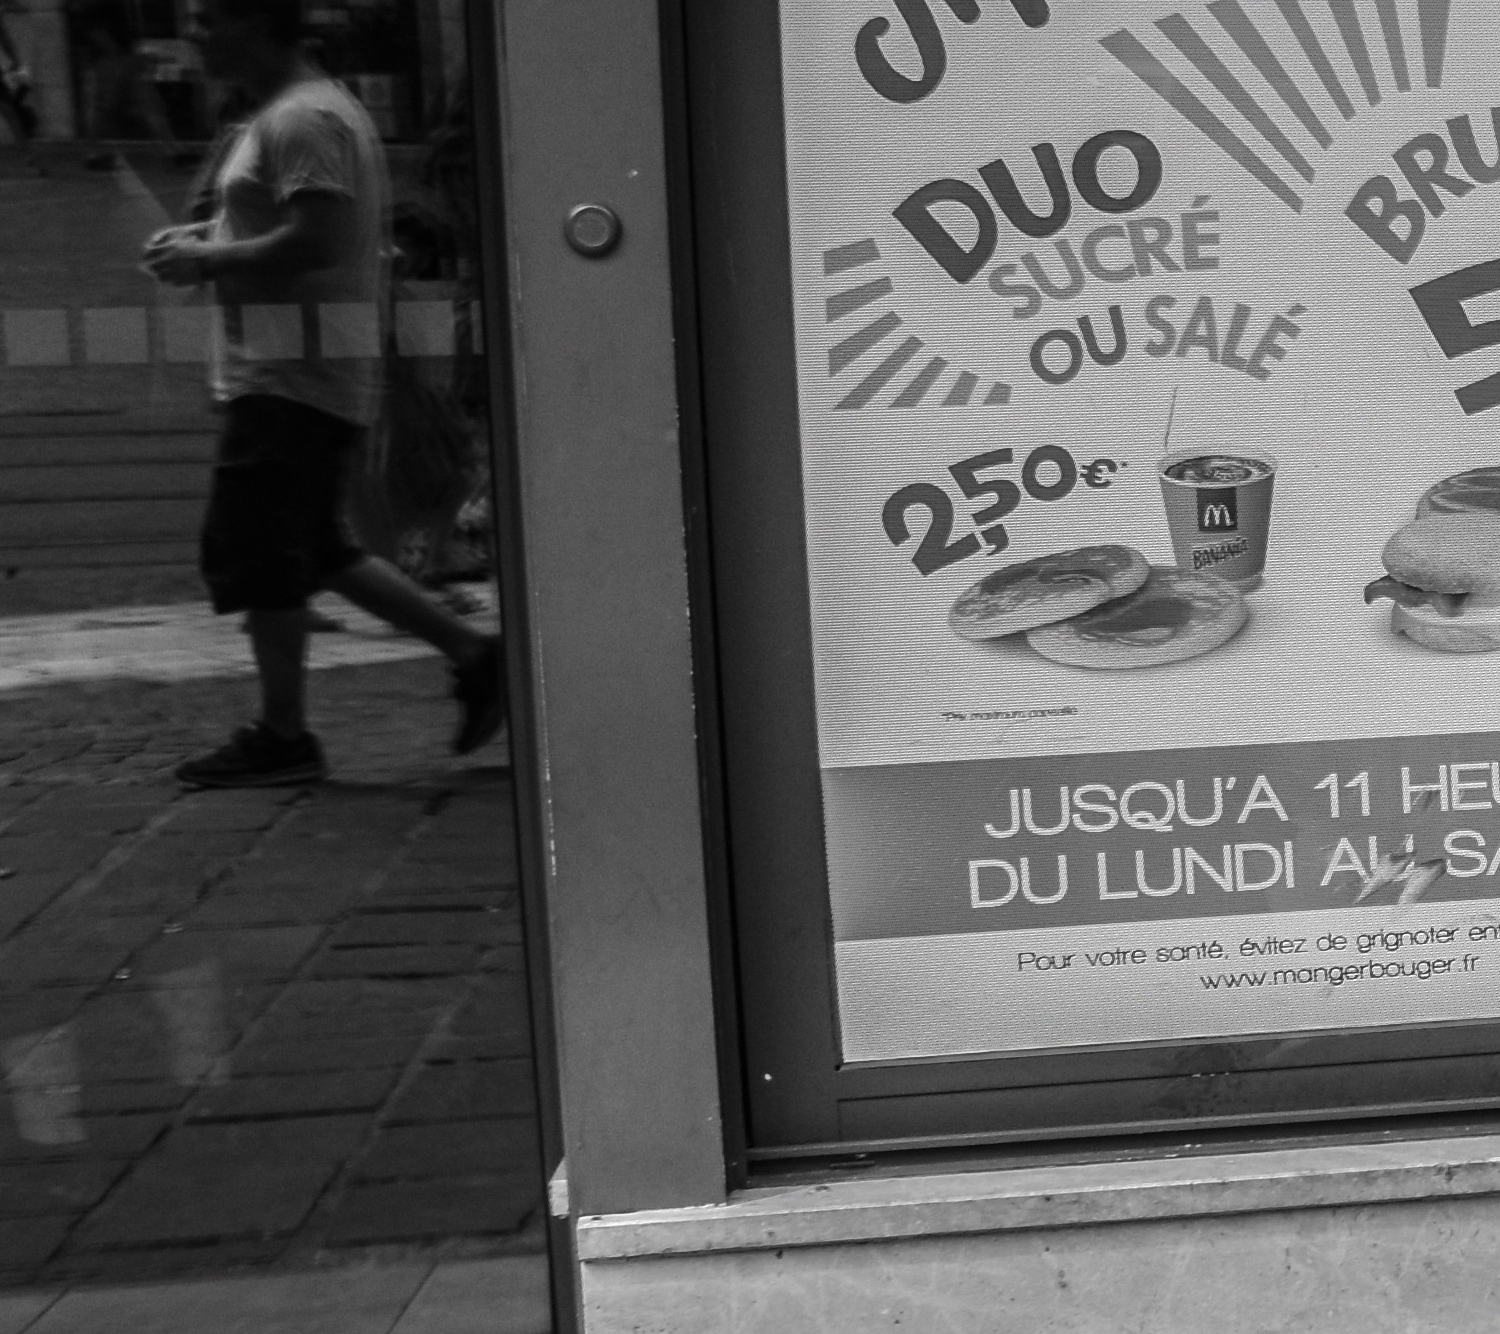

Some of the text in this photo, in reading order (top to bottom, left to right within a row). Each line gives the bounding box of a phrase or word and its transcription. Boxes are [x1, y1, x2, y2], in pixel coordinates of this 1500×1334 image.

[891, 128, 1163, 284] DUO
[986, 195, 1221, 321] SUCRÉ
[1027, 295, 1307, 386] OU SALÉ
[983, 772, 1290, 841] JUSQU'A
[1313, 770, 1374, 819] 11
[966, 853, 1069, 910] DU
[1096, 840, 1295, 903] LUNDI
[1320, 831, 1414, 888] AU
[1017, 950, 1076, 973] Pour
[1084, 947, 1147, 969] votre
[1238, 935, 1308, 958] évitez
[1316, 931, 1349, 953] de
[1355, 924, 1461, 954] grignoter
[1200, 952, 1481, 993] www.mangerbouger.fr
